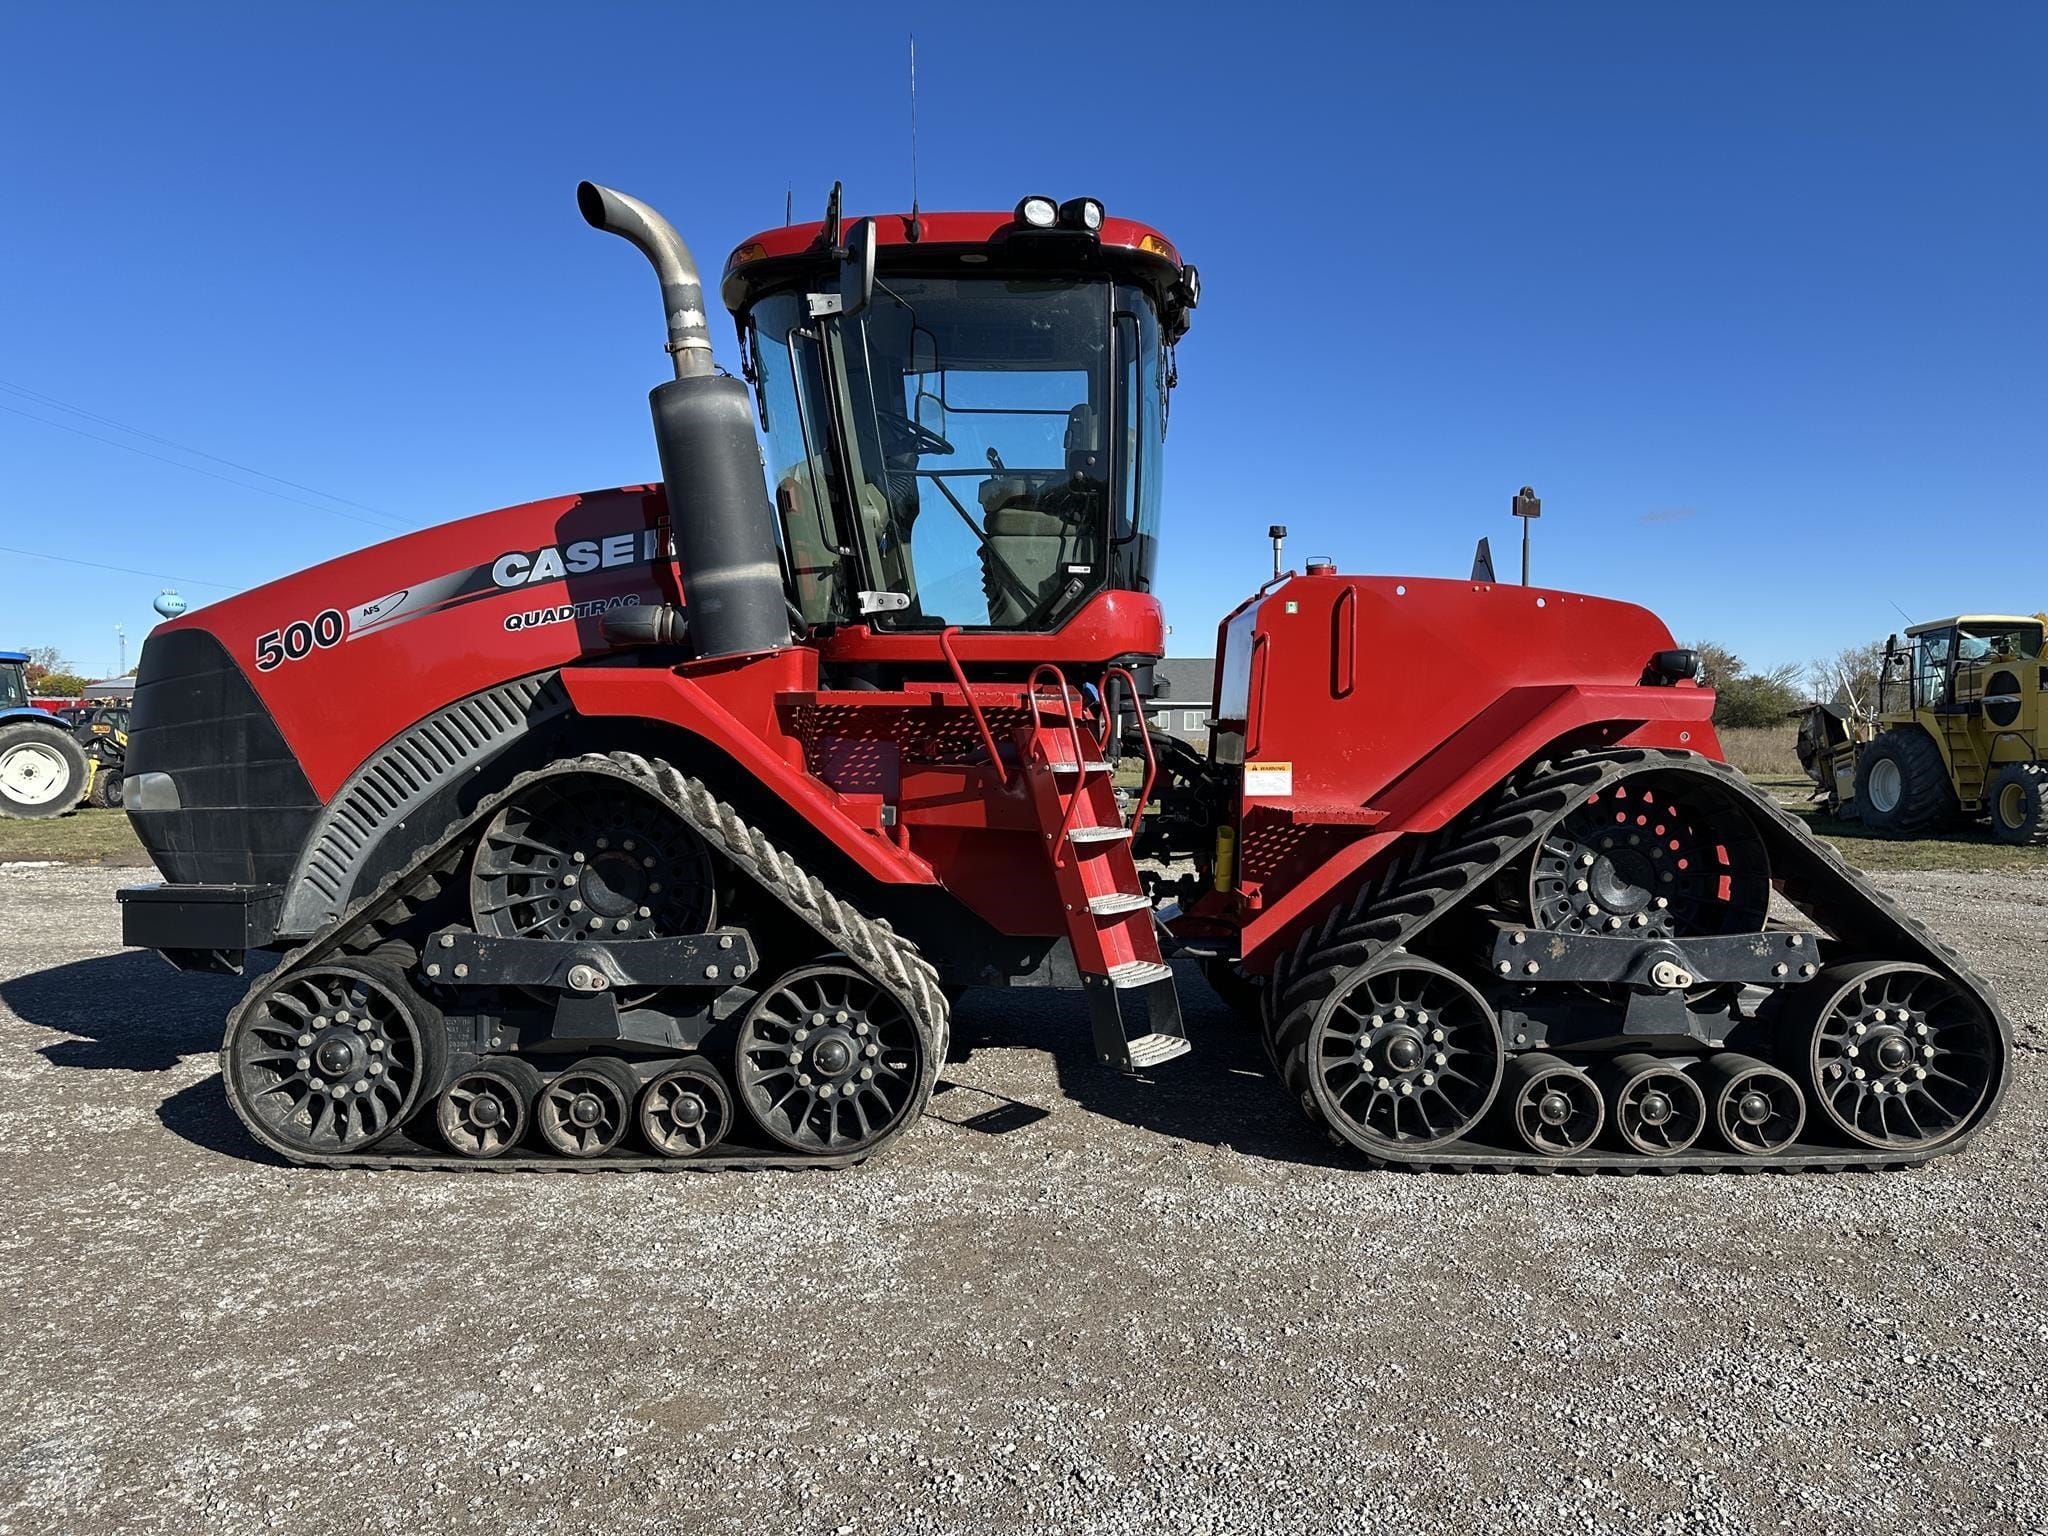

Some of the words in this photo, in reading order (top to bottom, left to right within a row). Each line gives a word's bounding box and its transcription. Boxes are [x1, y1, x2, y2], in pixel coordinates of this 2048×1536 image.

[492, 533, 634, 588] CASE
[362, 604, 381, 617] AFS
[504, 594, 641, 631] QUADTRAC
[255, 608, 344, 673] 500
